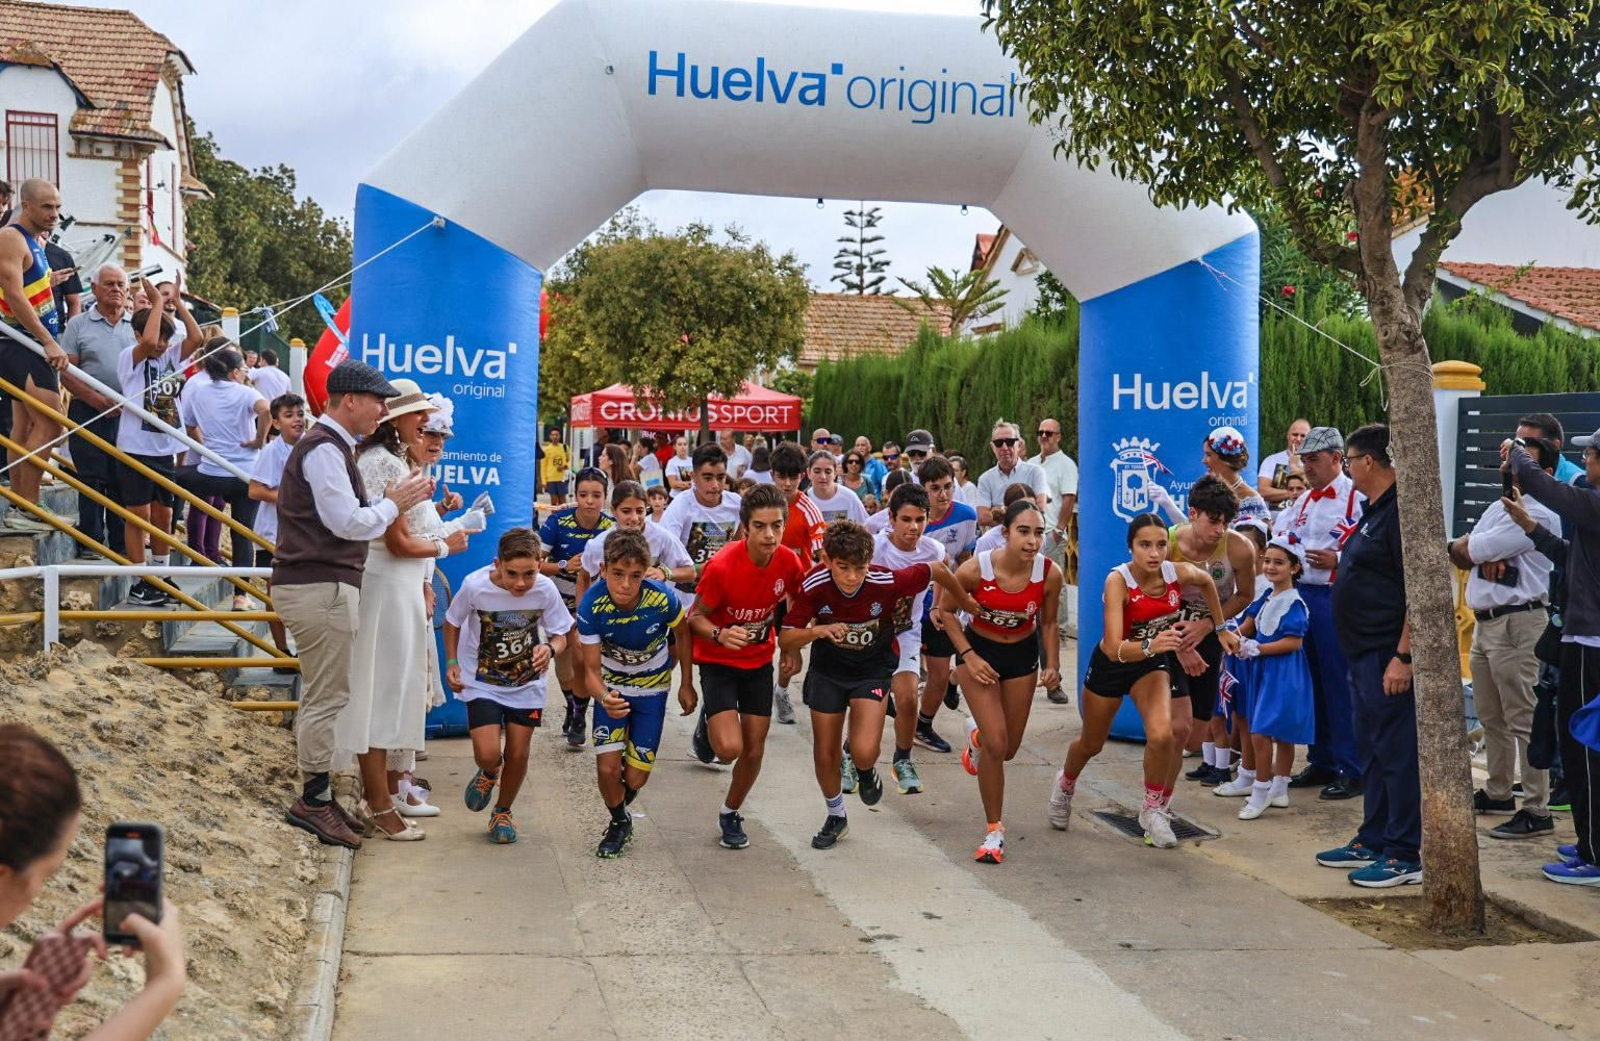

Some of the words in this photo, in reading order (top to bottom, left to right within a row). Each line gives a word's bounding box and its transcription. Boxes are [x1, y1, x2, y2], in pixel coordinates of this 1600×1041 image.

[648, 50, 826, 107] Huelva
[847, 66, 1015, 124] original
[362, 333, 506, 380] Huelva
[454, 382, 505, 399] original
[1113, 371, 1247, 410] Huelva
[1208, 413, 1248, 427] original
[441, 450, 487, 462] amiento
[489, 452, 502, 463] de
[426, 464, 500, 485] UELVA
[496, 632, 532, 659] 364
[846, 631, 873, 645] 60
